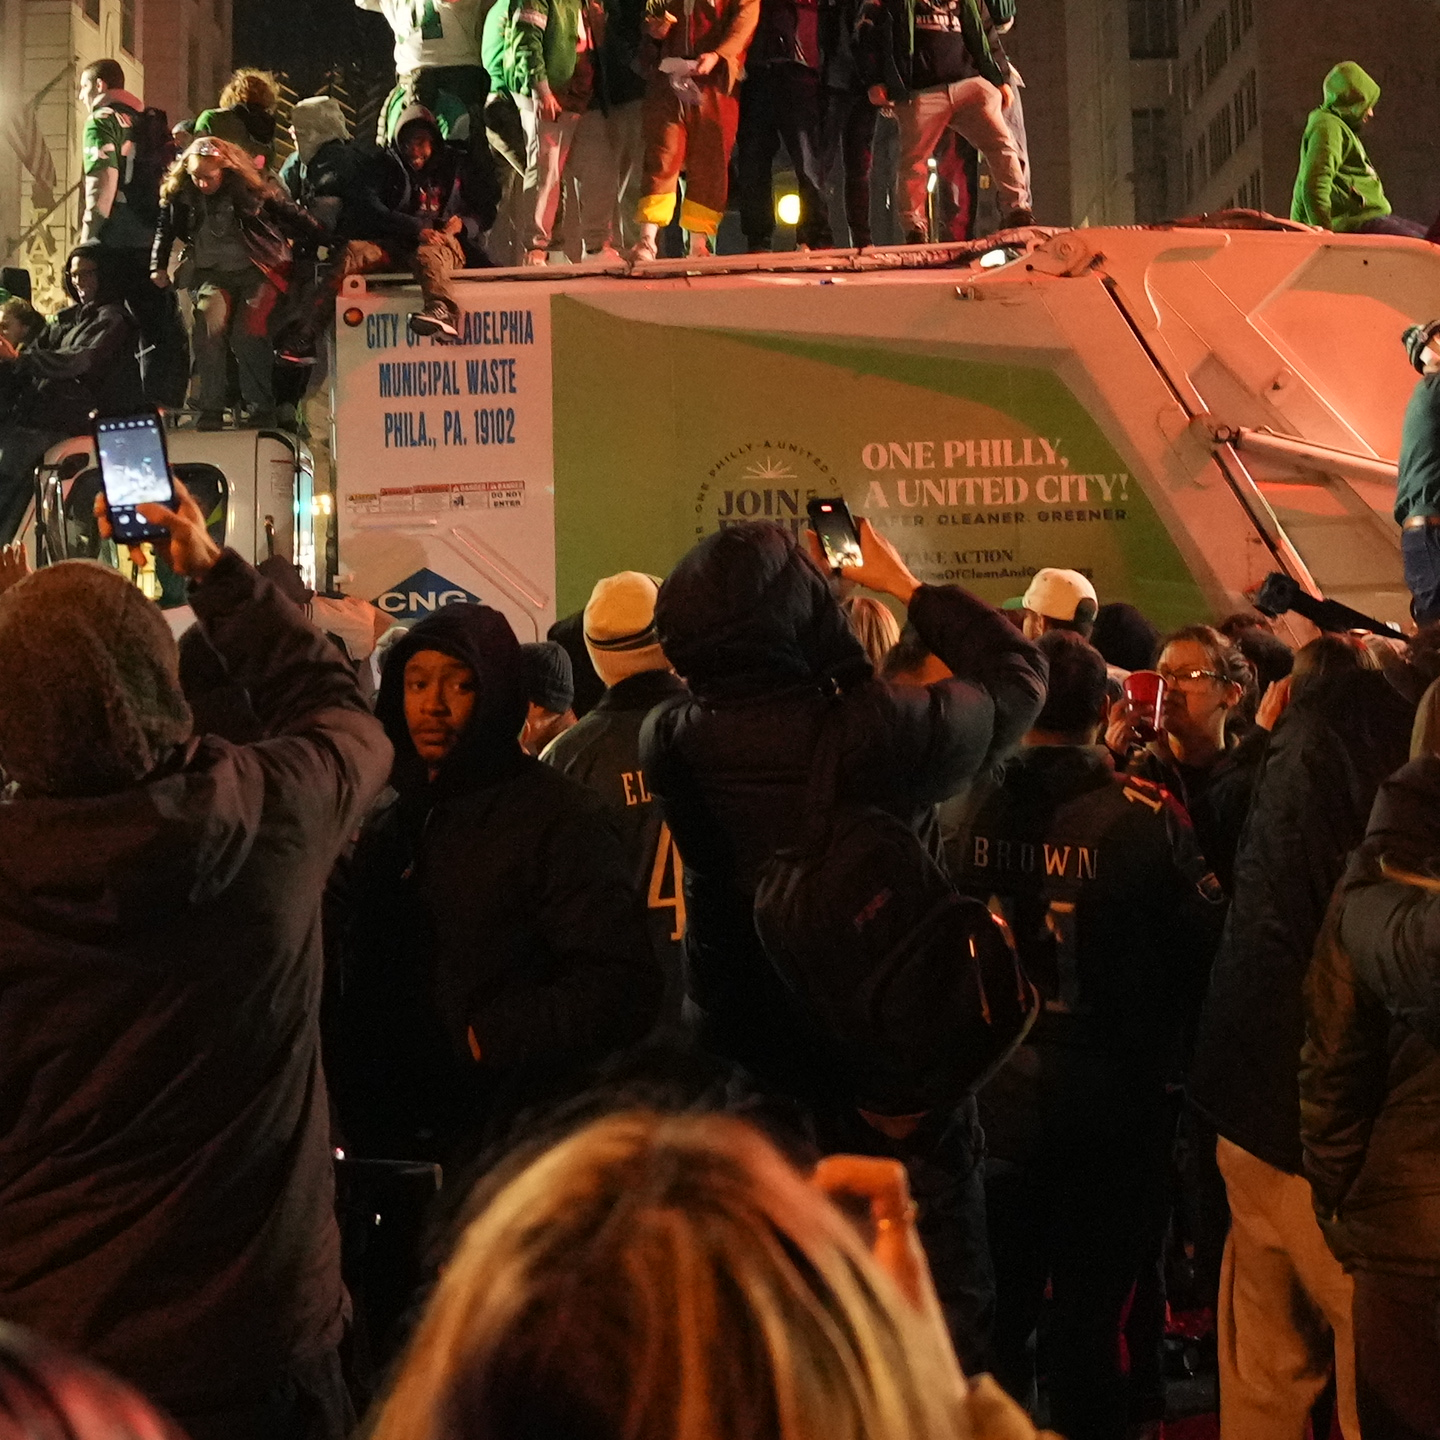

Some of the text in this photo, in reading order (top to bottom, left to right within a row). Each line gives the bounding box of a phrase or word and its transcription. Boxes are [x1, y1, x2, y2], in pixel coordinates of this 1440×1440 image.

[366, 312, 400, 349] CITY
[378, 358, 517, 398] MUNICIPAL WASTE
[443, 409, 467, 447] PA.
[474, 407, 516, 446] 19102
[861, 436, 1070, 471] ONE PHILLY,
[717, 488, 800, 516] JOIN
[863, 479, 890, 508] A
[896, 475, 1030, 508] UNITED
[1035, 472, 1130, 503] CITY!
[951, 548, 1014, 565] ACTION
[974, 835, 1099, 879] BROWN
